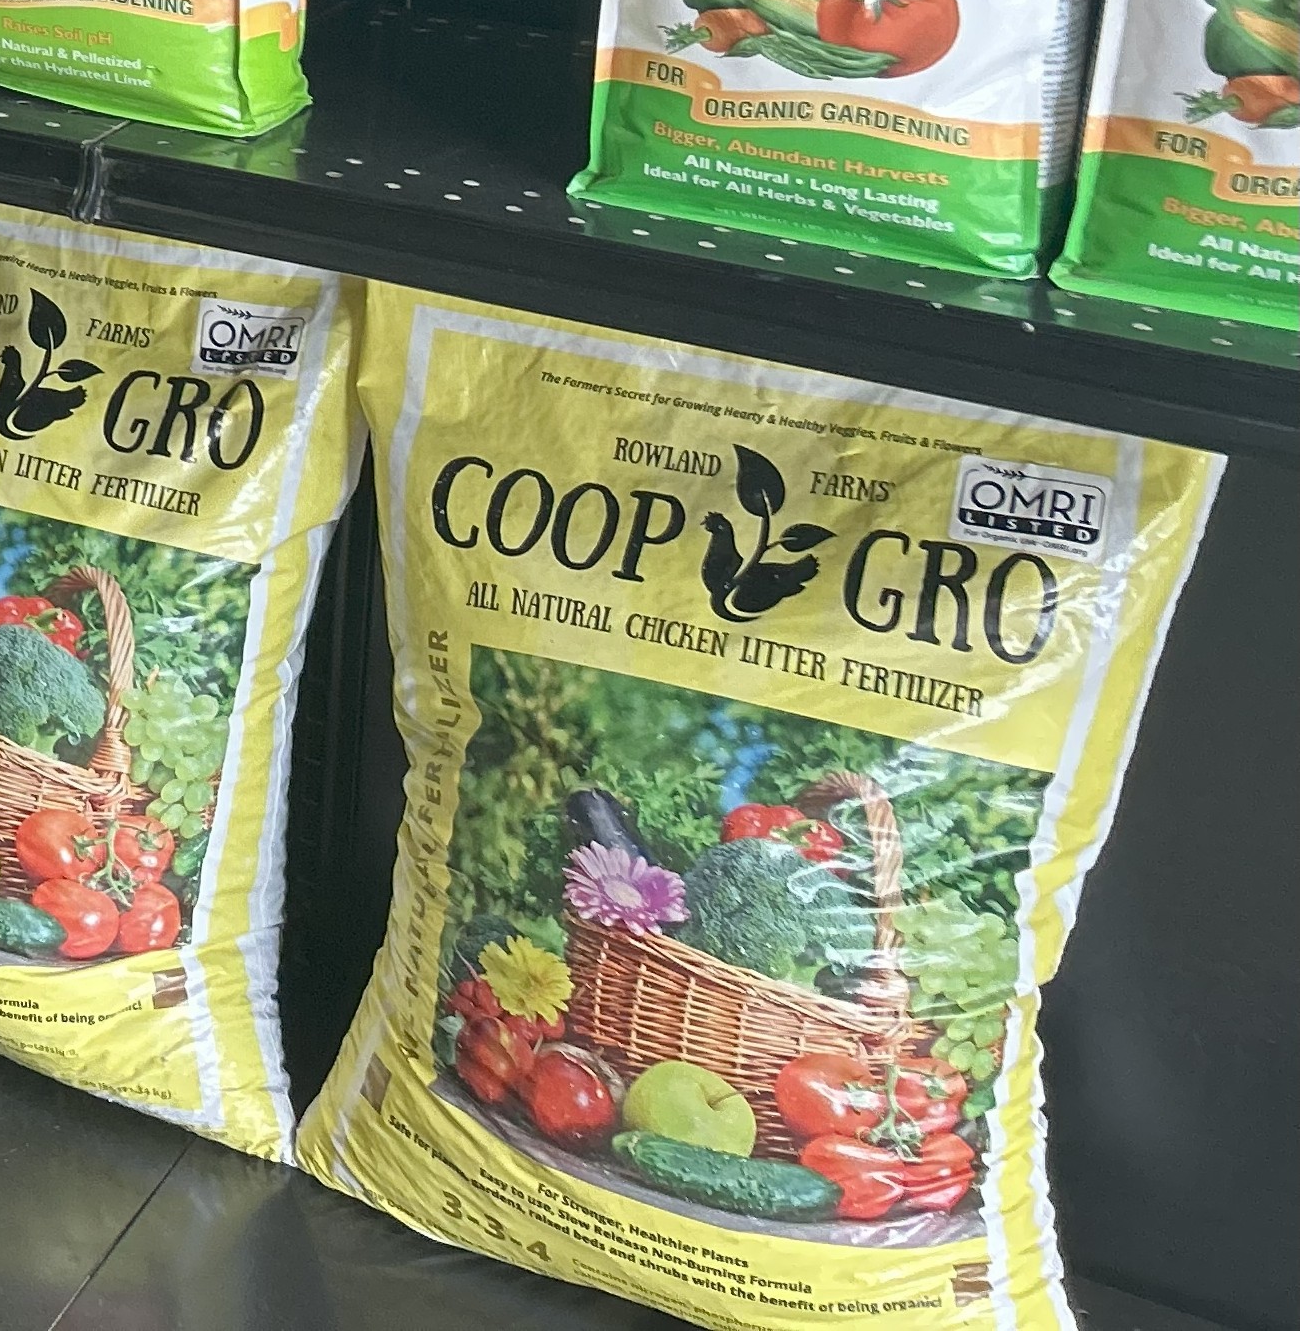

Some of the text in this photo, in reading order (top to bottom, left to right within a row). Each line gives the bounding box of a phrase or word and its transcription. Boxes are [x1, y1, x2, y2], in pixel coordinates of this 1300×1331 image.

[1, 15, 113, 47] Raises Soil pH
[2, 38, 54, 59] Natural
[57, 48, 68, 61] &
[72, 49, 141, 70] Pelletized
[10, 54, 41, 72] than
[44, 60, 109, 84] Hydrated
[113, 71, 152, 88] Lime
[644, 59, 686, 87] FOR
[704, 97, 971, 148] ORGANIC GARDENING
[1154, 130, 1207, 159] FOR
[653, 120, 950, 187] Bigger, Abundant Harvests
[684, 153, 940, 213] All Natural Long Lasting
[642, 162, 688, 183] Ideal
[692, 171, 721, 190] for
[725, 176, 753, 194] All
[757, 182, 817, 206] Herbs
[821, 194, 838, 211] &
[842, 200, 956, 232] Vegetables
[86, 317, 156, 350] FARMS
[208, 318, 298, 353] OMRI
[101, 368, 266, 471] GRO
[541, 371, 983, 457] The Farmer's Secret for Growing Hearty & Healthy Veggies, Fruits & Flowers
[14, 455, 82, 492] LITTER
[89, 472, 203, 518] FERTILIZER
[613, 436, 892, 502] ROWLAND FARMS
[962, 510, 1092, 544] LISTED
[970, 479, 1097, 525] OMRI
[431, 455, 1059, 665] COOP GRO
[465, 580, 985, 718] ALL NATURAL CHICKEN LITTER FERTILIZER
[440, 1190, 553, 1263] 3-3-4
[537, 1181, 750, 1269] For Stronger, Healthier Plants
